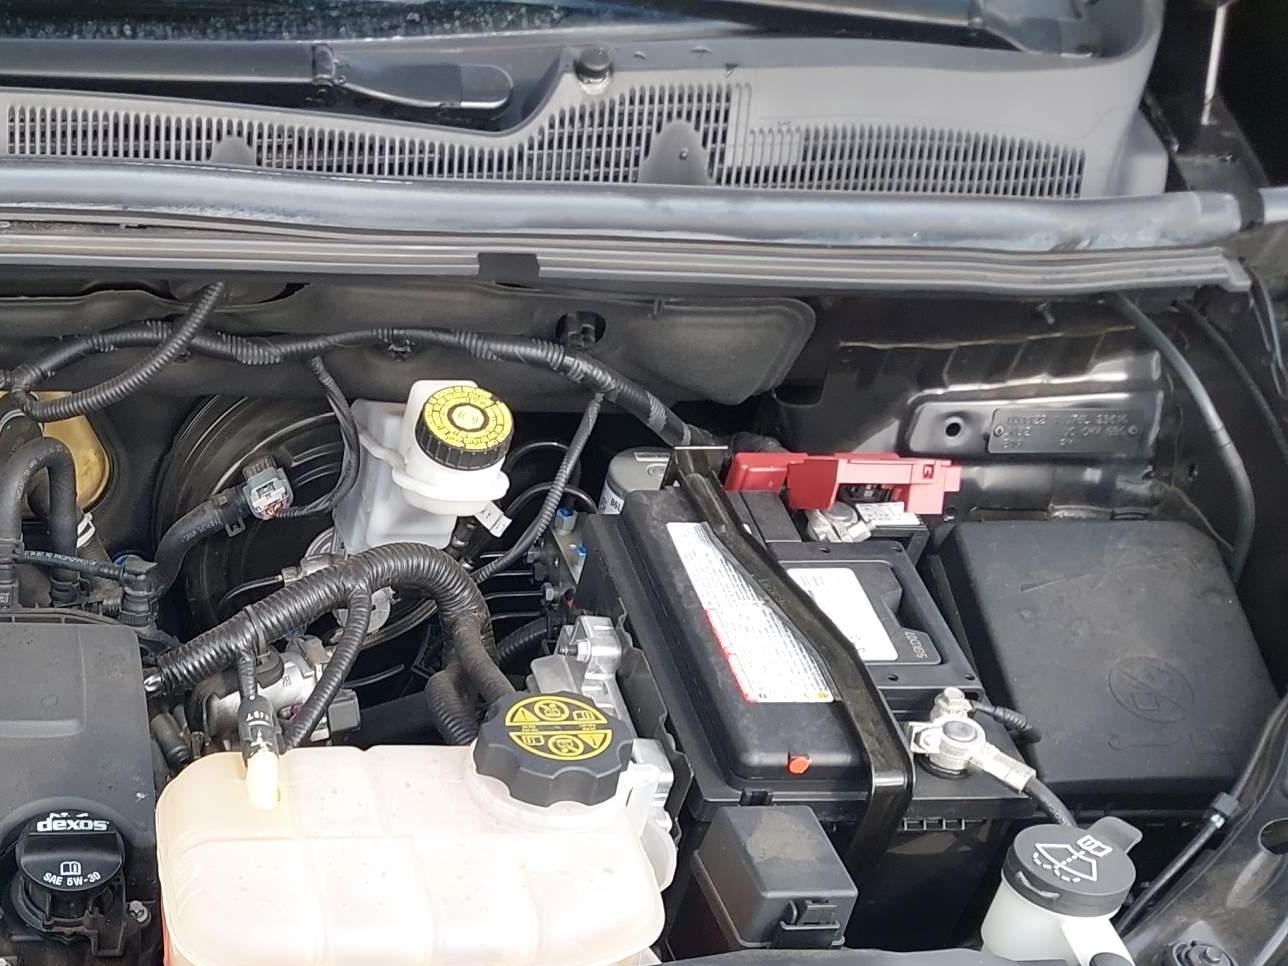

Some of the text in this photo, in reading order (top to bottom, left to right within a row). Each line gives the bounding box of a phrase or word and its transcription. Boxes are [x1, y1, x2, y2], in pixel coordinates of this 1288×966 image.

[37, 816, 108, 832] dexos
[43, 871, 101, 886] SAE 5W-30
